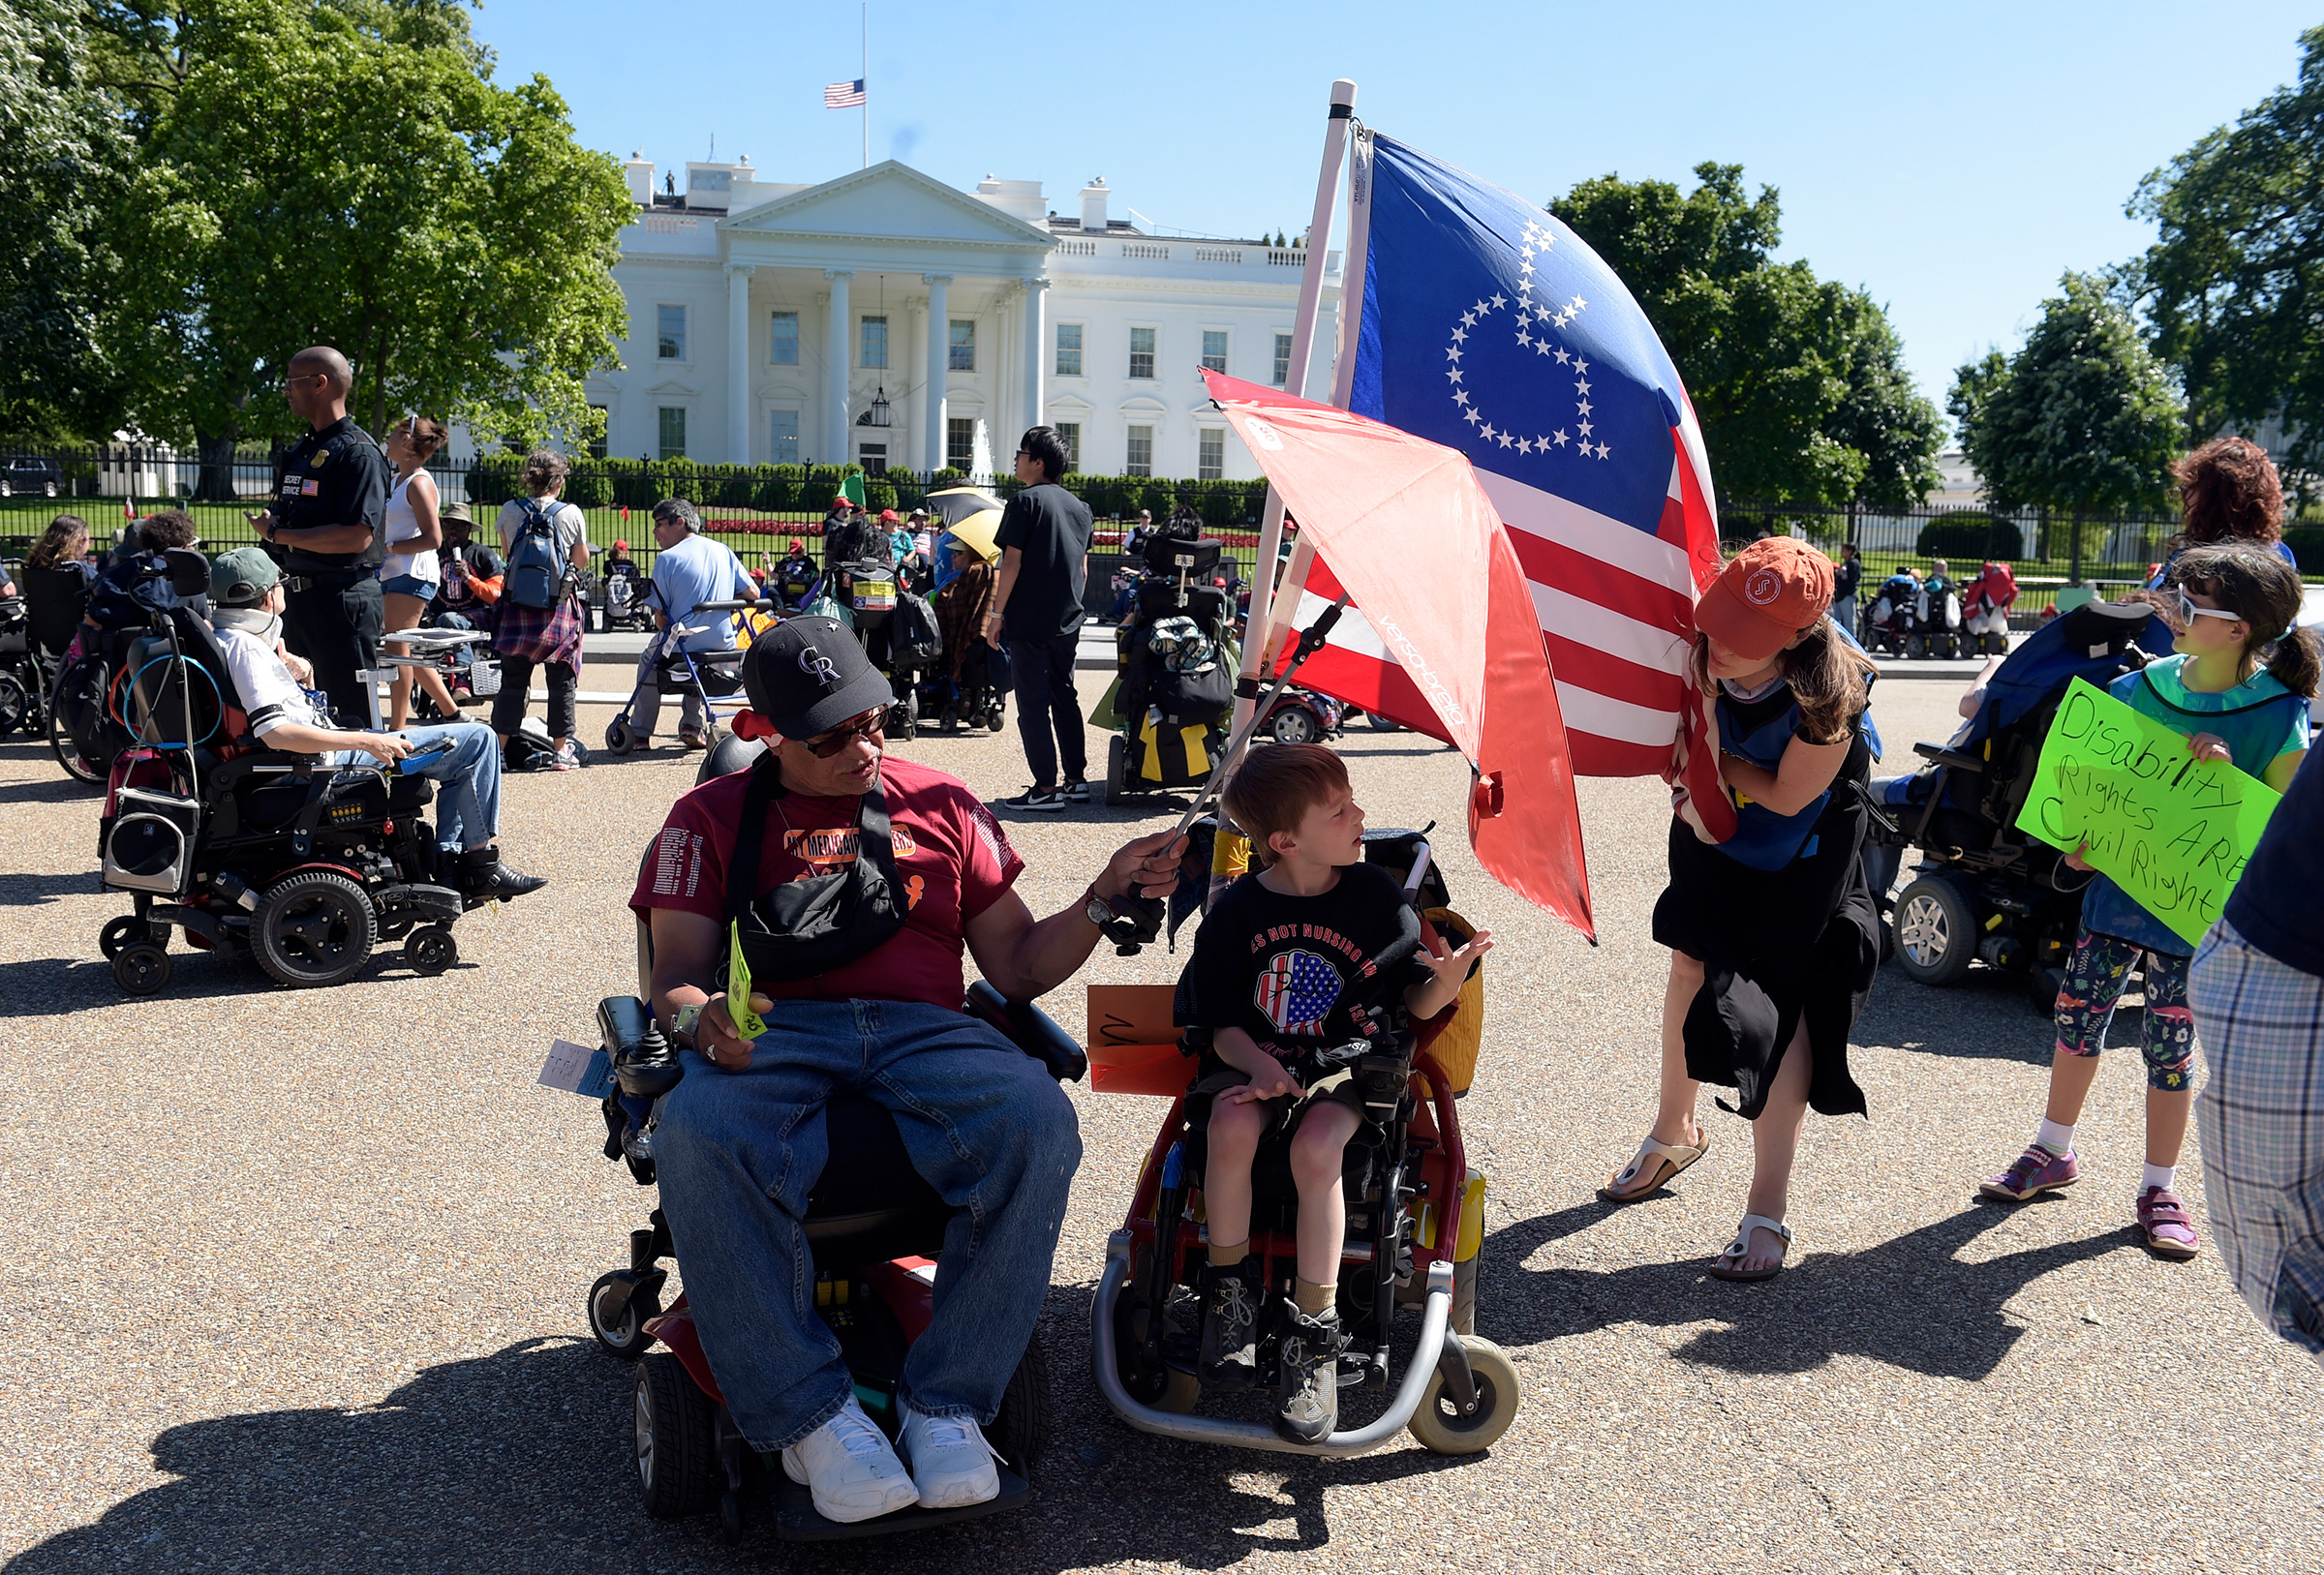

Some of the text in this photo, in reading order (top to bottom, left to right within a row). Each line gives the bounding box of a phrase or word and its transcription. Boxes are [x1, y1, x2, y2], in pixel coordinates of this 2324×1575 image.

[282, 485, 300, 496] SERVICE
[284, 474, 302, 485] SECRET
[1380, 615, 1465, 725] versa-brella
[2061, 690, 2243, 810] Disability
[2040, 797, 2125, 863] Civil
[2059, 754, 2248, 882] Rights ARE
[1267, 924, 1298, 942] NOT
[1302, 923, 1362, 963] NURSING
